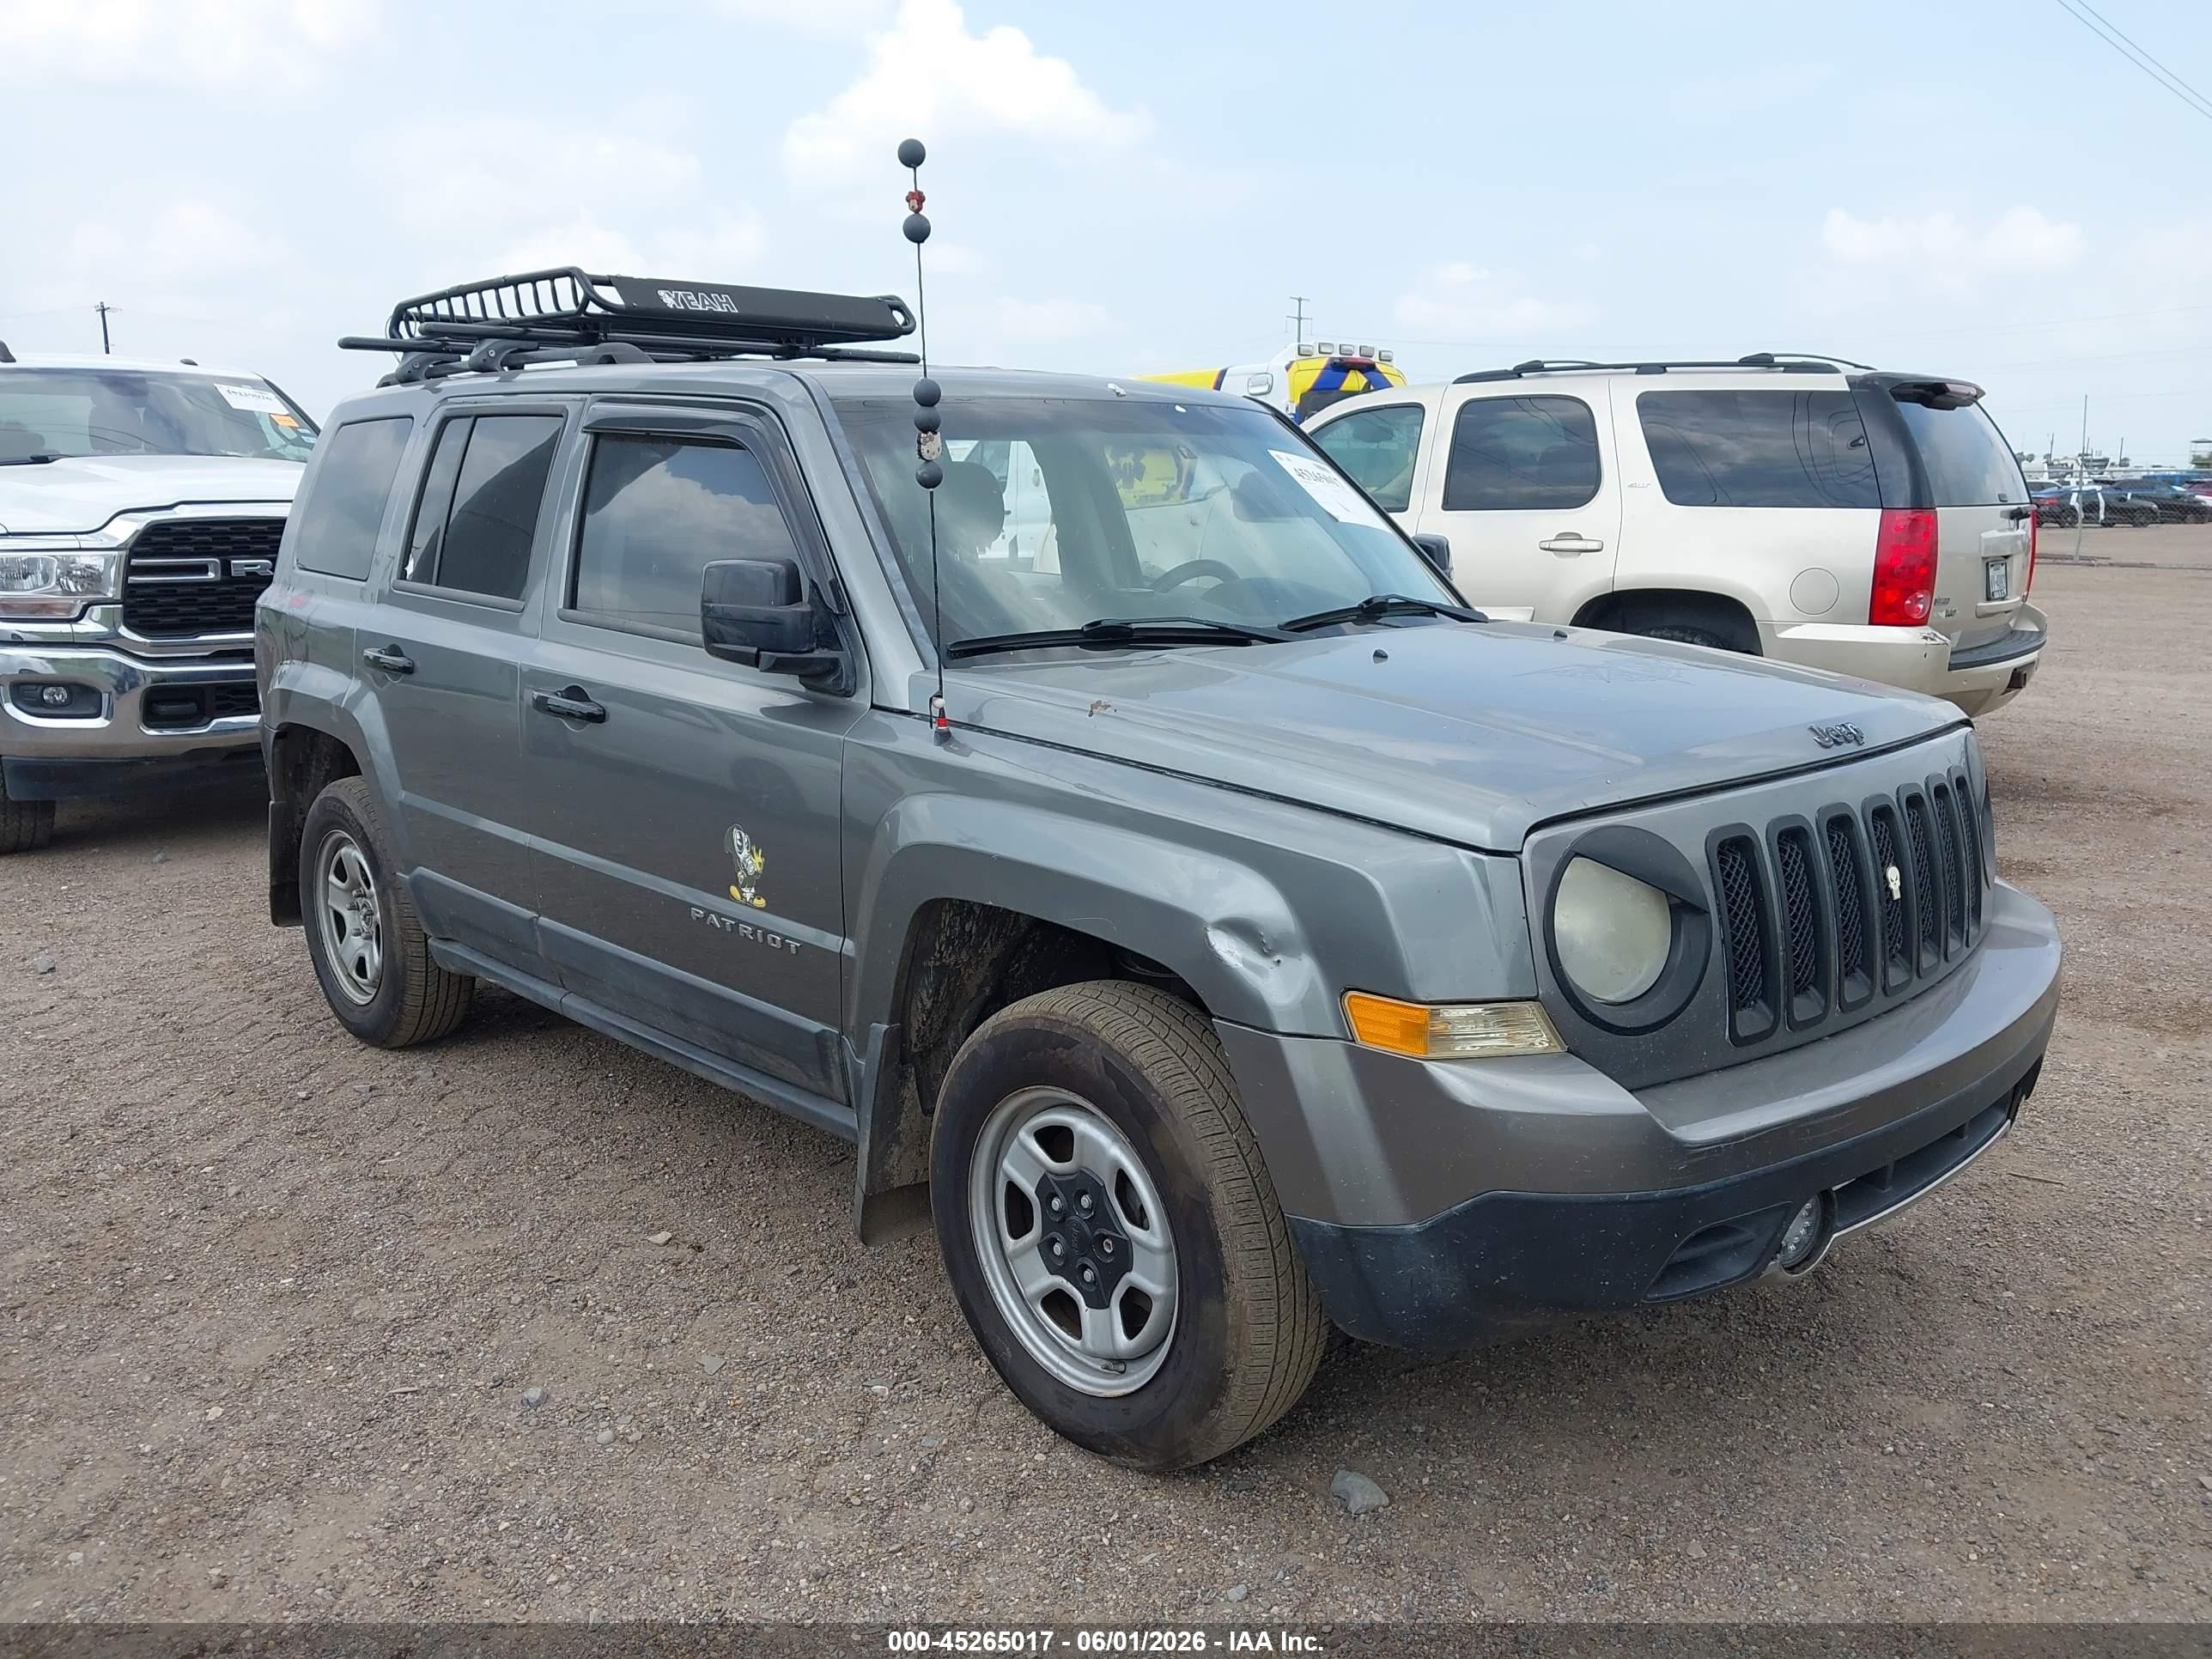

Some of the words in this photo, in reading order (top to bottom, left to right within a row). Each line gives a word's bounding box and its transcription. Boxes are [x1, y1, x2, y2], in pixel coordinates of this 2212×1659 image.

[668, 290, 738, 313] YEAH
[1808, 723, 1865, 750] Jeep
[690, 907, 801, 955] PATRIOT
